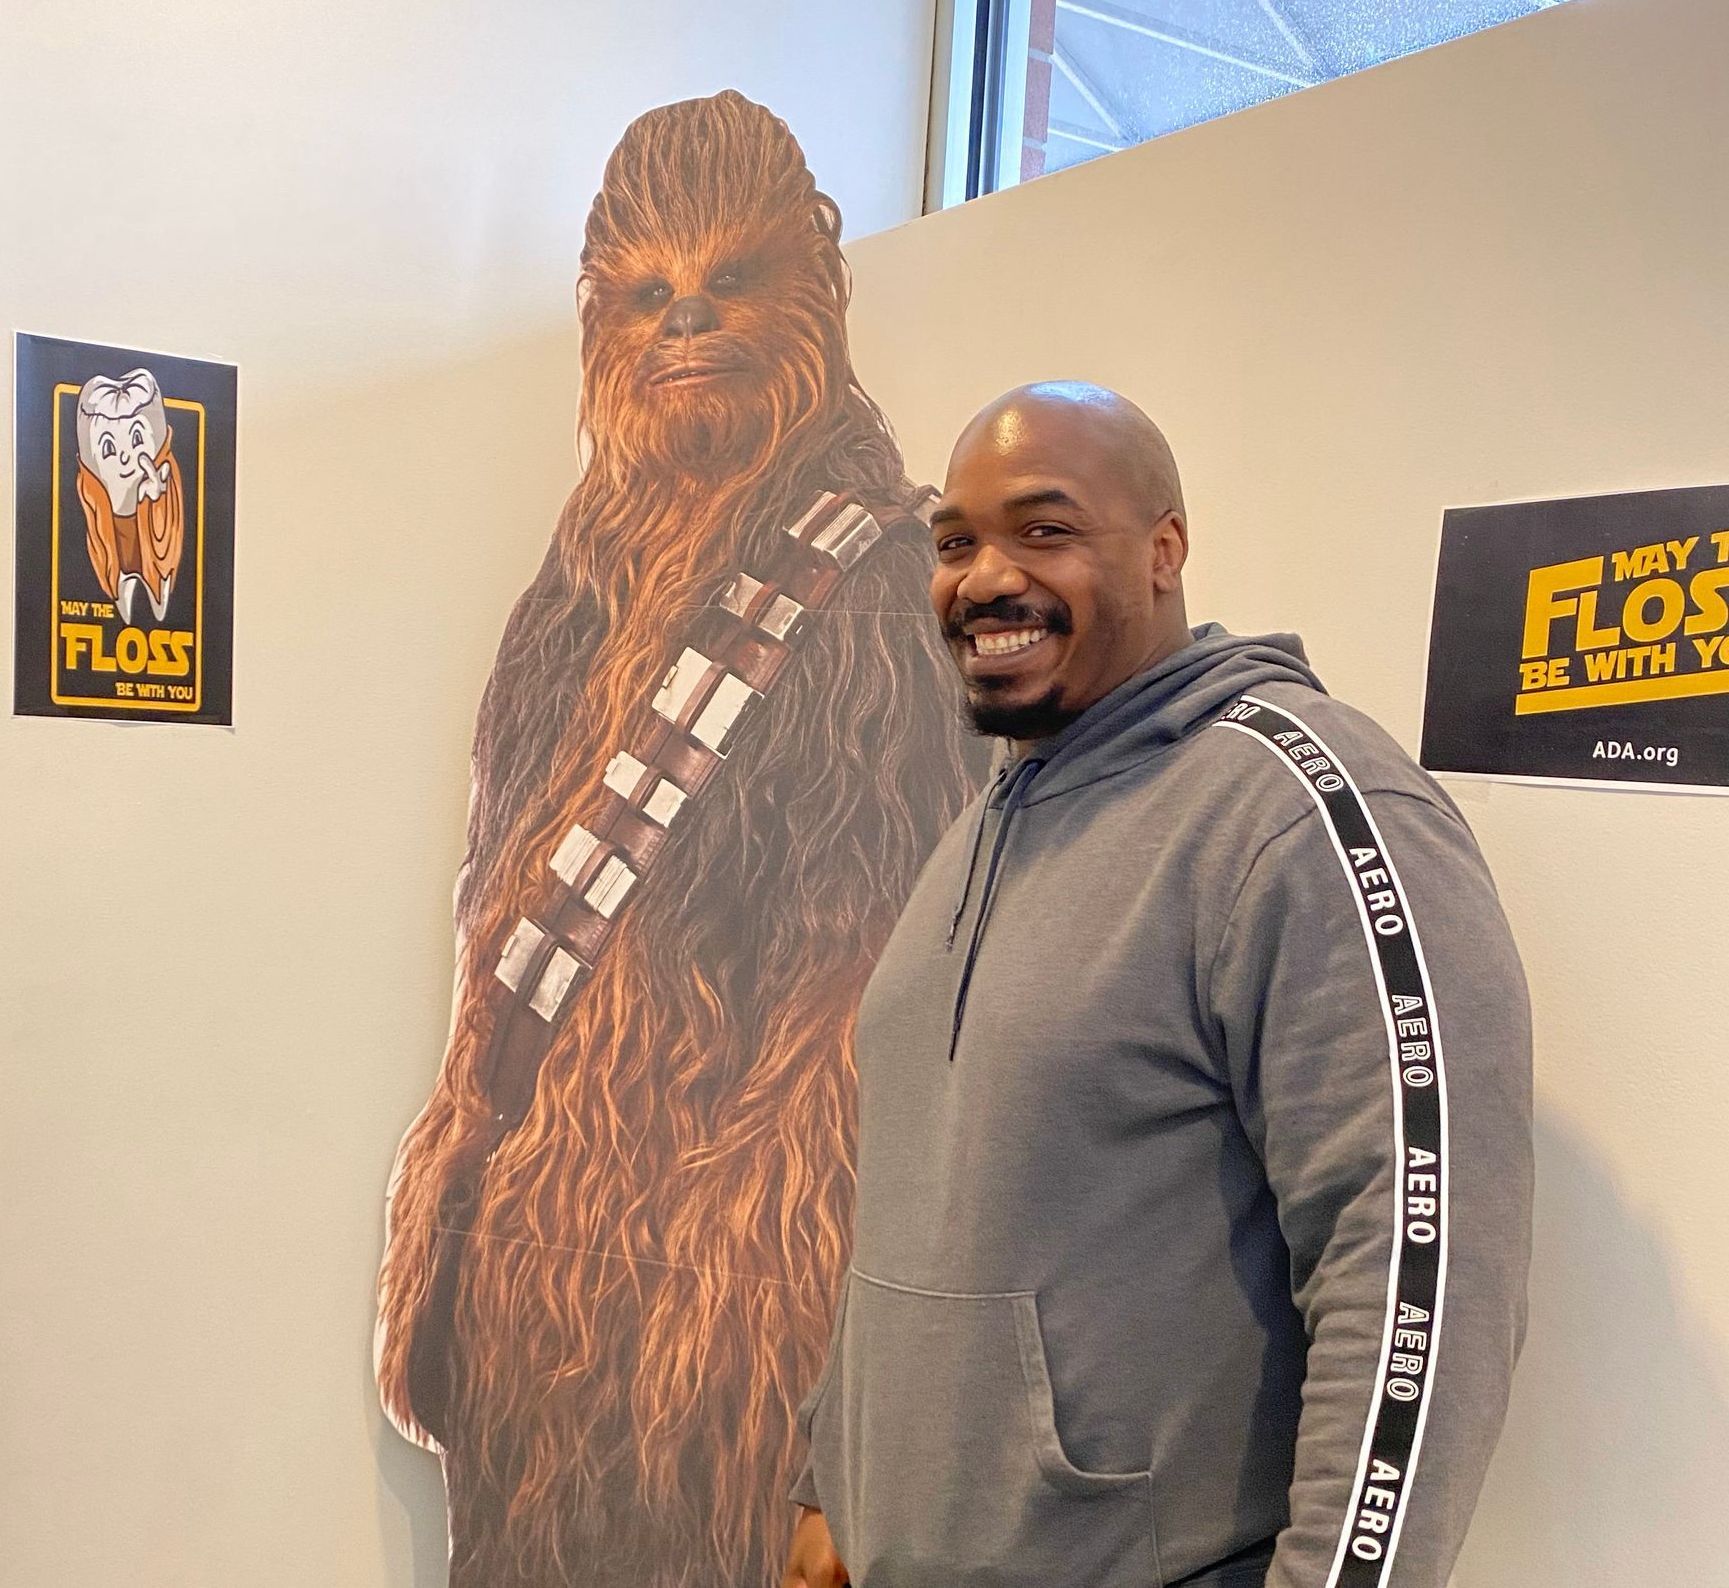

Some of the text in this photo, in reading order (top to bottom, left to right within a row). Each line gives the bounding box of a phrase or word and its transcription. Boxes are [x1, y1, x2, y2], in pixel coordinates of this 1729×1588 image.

[1612, 536, 1699, 582] MAY
[60, 600, 115, 619] MAY THE
[60, 622, 194, 677] FLOSS
[1519, 657, 1570, 691] BE
[1585, 642, 1677, 683] WITH
[115, 682, 193, 700] BE WITH YOU
[1592, 740, 1679, 767] ADA.org
[1220, 702, 1437, 1561] RO AERO AERO AERO AERO AERO AERO
